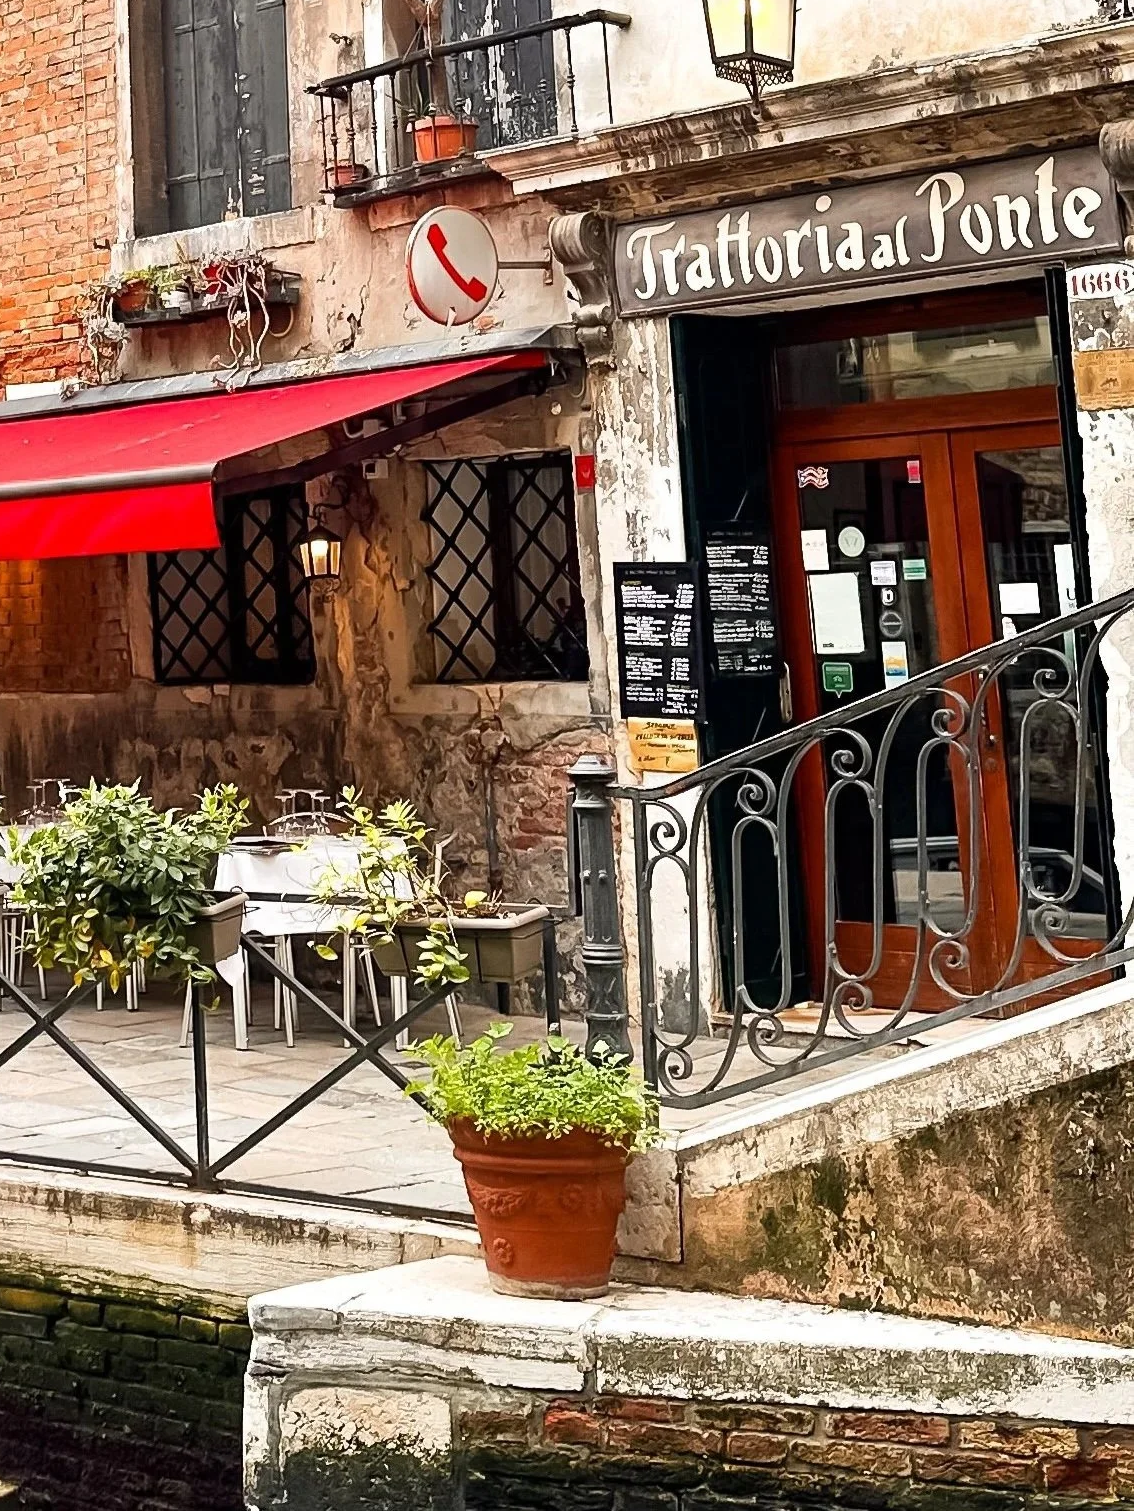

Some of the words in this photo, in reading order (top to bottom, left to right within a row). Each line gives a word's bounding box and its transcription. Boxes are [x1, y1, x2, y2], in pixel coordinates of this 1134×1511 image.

[626, 195, 866, 301] Trattoria
[870, 214, 912, 270] al
[915, 155, 1102, 264] Ponte
[1072, 270, 1130, 296] 1666
